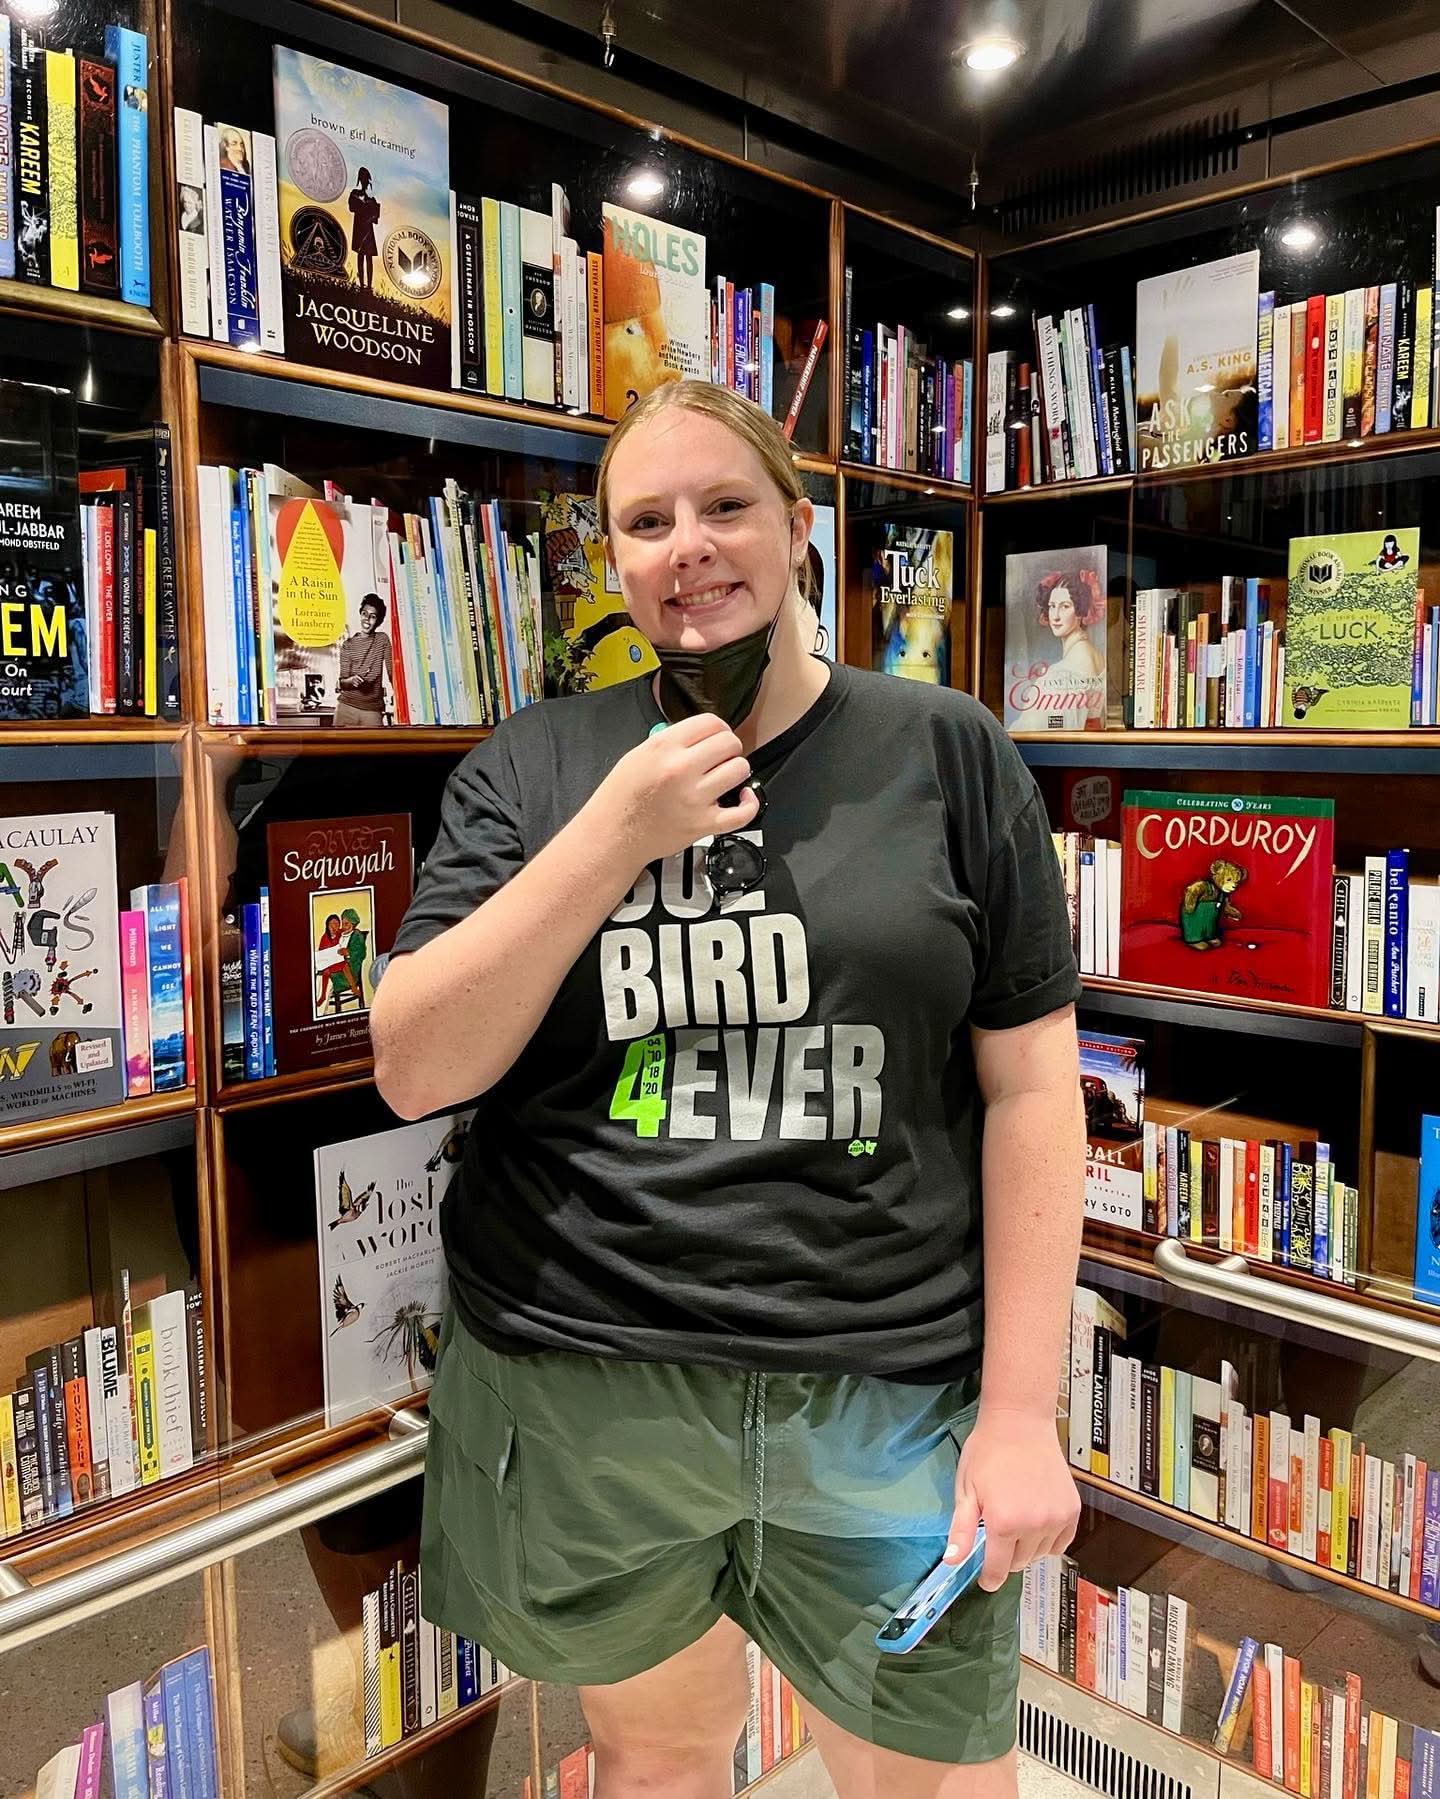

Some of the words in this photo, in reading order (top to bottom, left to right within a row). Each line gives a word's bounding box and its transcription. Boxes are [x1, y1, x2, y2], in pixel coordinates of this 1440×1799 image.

[132, 42, 142, 82] JUSTER
[311, 113, 346, 135] brown
[349, 127, 366, 142] girl
[370, 133, 416, 159] dreaming
[20, 121, 41, 195] KAREEM
[132, 139, 143, 198] PHANTOM
[224, 198, 234, 241] WALTER
[231, 193, 248, 253] Benjamin
[133, 202, 144, 272] TOLLBOOTH
[612, 215, 699, 277] HOLES
[226, 247, 237, 305] ISAACSON
[236, 252, 256, 309] Franklin
[465, 243, 473, 296] GENTLEMAN
[296, 295, 435, 344] JACQUELINE
[1044, 323, 1053, 346] WAY
[310, 322, 422, 366] WOODSON
[1381, 335, 1393, 371] NATE
[1397, 338, 1410, 380] KAREEM
[664, 359, 679, 370] Book
[1046, 351, 1056, 389] THINGS
[1109, 364, 1115, 374] TO
[1187, 361, 1213, 374] A.S.
[1218, 352, 1251, 367] KING
[791, 390, 804, 417] POWER
[1050, 392, 1059, 425] WORK
[1150, 399, 1192, 433] ASK
[1111, 406, 1122, 452] Mockingbird
[1161, 431, 1181, 443] THE
[1142, 431, 1248, 469] PASSENGERS
[22, 539, 60, 550] OBSTFELD
[162, 556, 173, 598] GREEK
[290, 576, 298, 586] A
[302, 576, 334, 589] Raisin
[884, 549, 941, 593] Tuck
[1300, 553, 1316, 584] NATIONAL
[1317, 551, 1334, 560] BOOK
[122, 576, 130, 605] WOMEN
[286, 588, 296, 598] in
[300, 589, 316, 600] the
[318, 592, 338, 601] Sun
[464, 572, 472, 598] SEVEN
[880, 586, 946, 612] Everlasting
[164, 599, 175, 640] MYTHS
[291, 618, 335, 631] Hansberry
[295, 608, 332, 618] Lorraine
[467, 601, 476, 626] BLIND
[471, 630, 479, 651] MICE
[1319, 621, 1378, 640] LUCK
[1136, 614, 1146, 693] SHAKESPEARE
[5, 664, 27, 677] On
[1043, 679, 1063, 687] JANE
[1069, 677, 1103, 687] AUSTEN
[1009, 661, 1103, 711] Emma
[1177, 798, 1230, 808] CELEBRATING
[1245, 801, 1272, 810] YEARS
[283, 840, 395, 889] Sequoyah
[1136, 814, 1317, 885] CORDUROY
[1368, 870, 1381, 900] PALACE
[1389, 868, 1404, 891] bel
[150, 905, 163, 913] ALL
[1368, 902, 1381, 925] WALK
[1388, 893, 1400, 935] canto
[155, 923, 177, 932] LIGHT
[128, 928, 138, 966] Milkman
[160, 943, 172, 951] WE
[152, 962, 182, 971] CANNOT
[249, 949, 258, 976] WHERE
[600, 913, 810, 1042] BIRD
[1390, 961, 1400, 995] Patchett
[250, 992, 258, 1007] RED
[250, 1009, 259, 1029] FERN
[80, 1041, 107, 1051] Revised
[250, 1031, 259, 1058] GROWS
[80, 1058, 109, 1069] Updated
[6, 1098, 39, 1110] WORLD
[51, 1087, 97, 1102] MACHINES
[10, 1084, 62, 1100] WINDMILLS
[643, 1083, 658, 1094] '20
[376, 1176, 434, 1224] lost
[1180, 1172, 1188, 1202] KAREEM
[1102, 1202, 1132, 1217] SOTO
[375, 1258, 401, 1270] ROBERT
[386, 1266, 408, 1279] JACKIE
[410, 1259, 435, 1271] MORRIS
[101, 1337, 118, 1399] BLUME
[160, 1325, 180, 1382] book
[51, 1355, 59, 1386] PATERSON
[25, 1410, 35, 1432] PHILIP
[53, 1400, 63, 1427] Bridge
[163, 1385, 183, 1438] thief
[1092, 1373, 1104, 1445] LANGUAGE
[15, 1410, 27, 1439] PULLMAN
[21, 1453, 32, 1495] COMPASS
[1423, 1551, 1439, 1577] SPARK
[1168, 1604, 1179, 1646] MUSEUM
[464, 1640, 473, 1677] Patchett
[1165, 1645, 1177, 1689] PLANNING
[1236, 1673, 1248, 1696] NOAH
